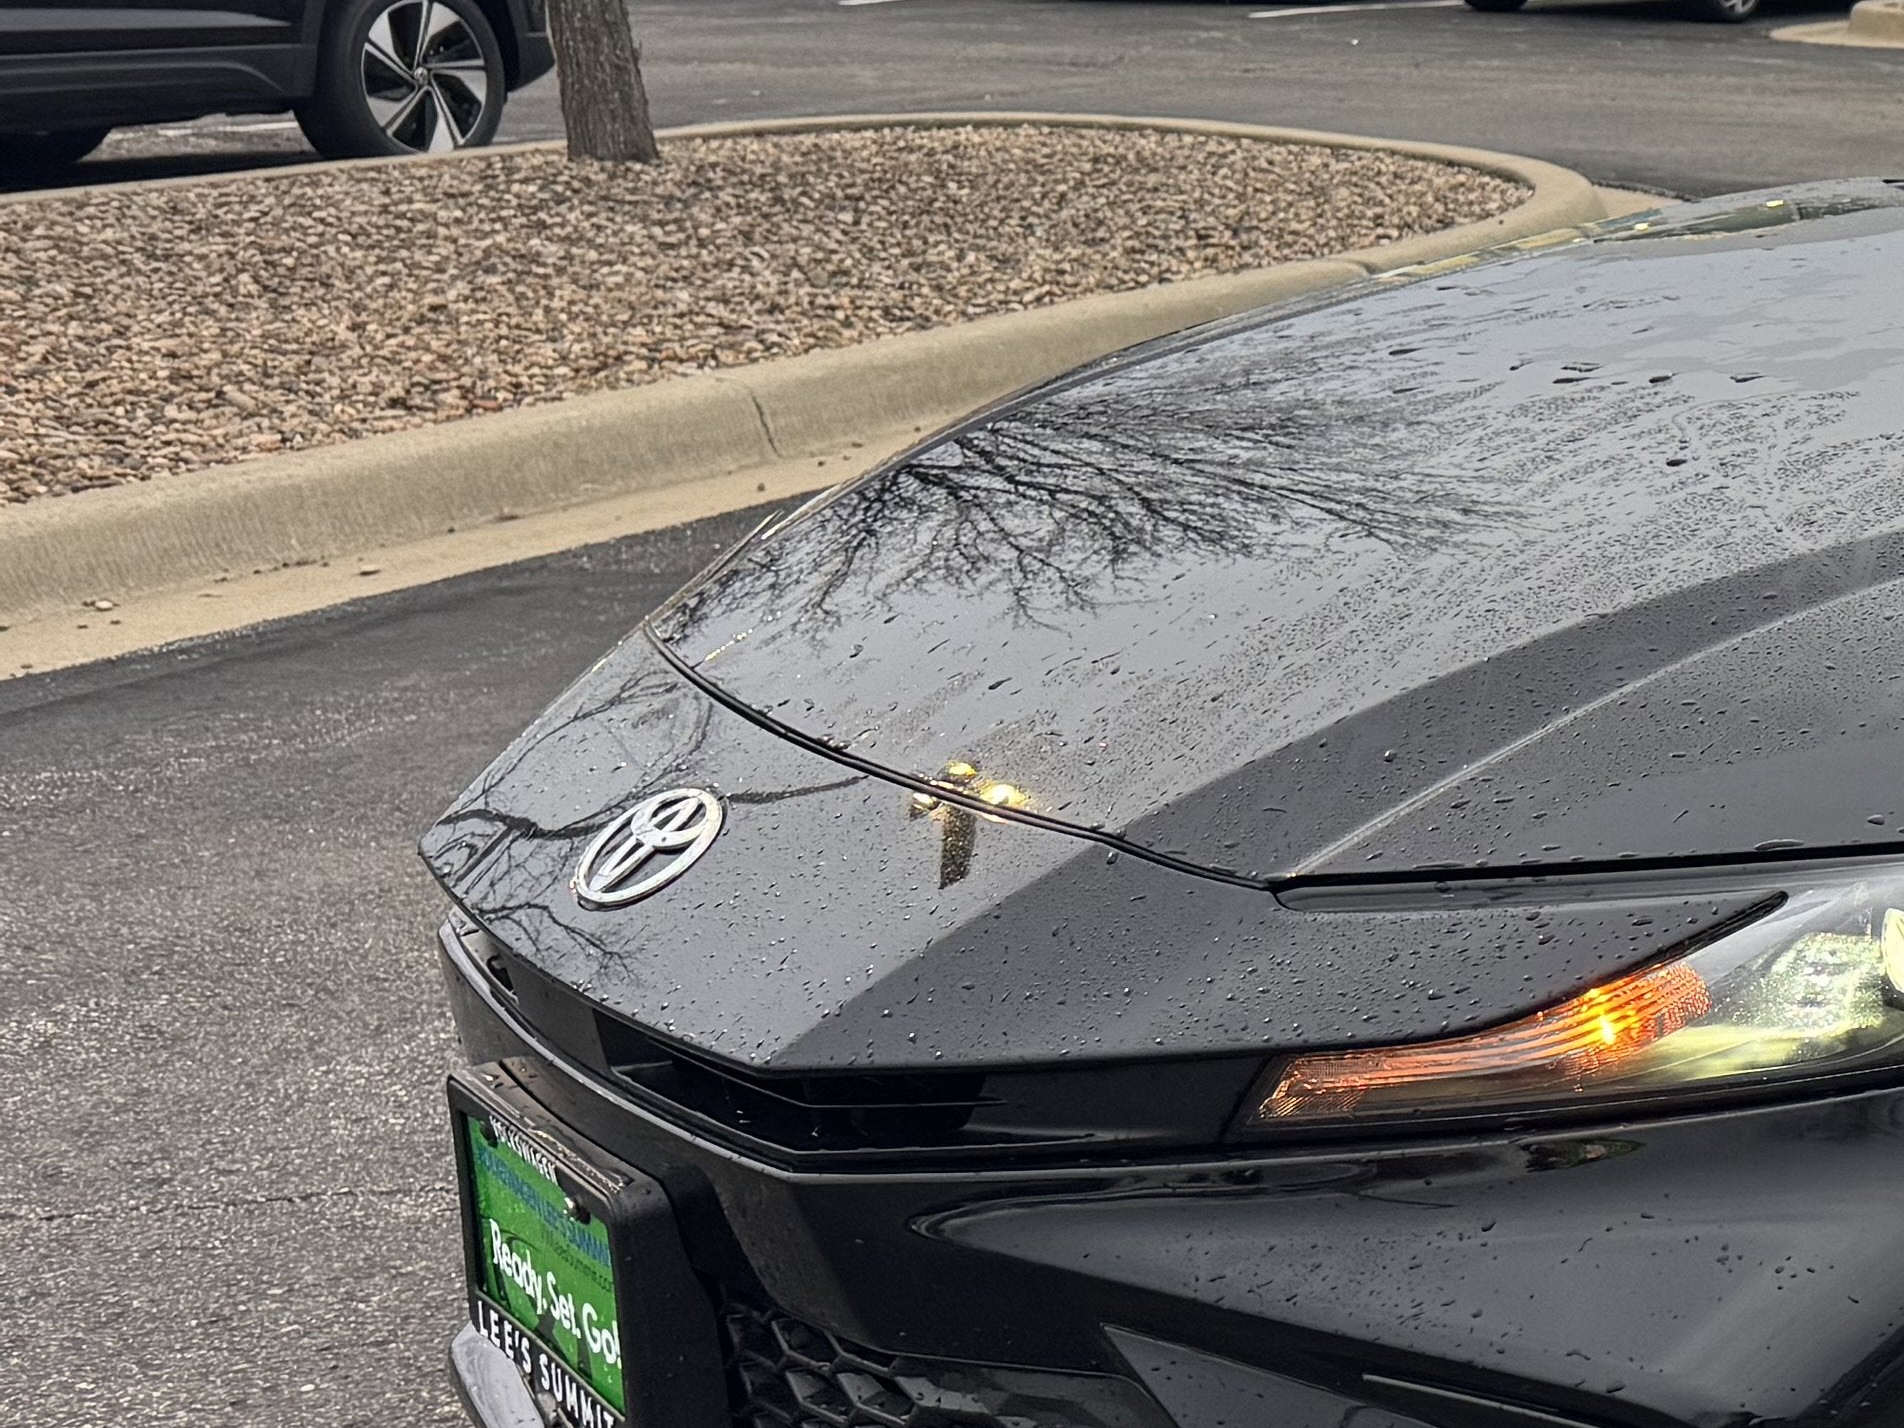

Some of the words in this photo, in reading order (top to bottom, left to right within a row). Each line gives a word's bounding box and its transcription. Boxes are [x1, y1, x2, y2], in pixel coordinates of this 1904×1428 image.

[477, 1300, 532, 1374] LEE'S
[490, 1218, 548, 1315] Ready.
[547, 1271, 581, 1339] Set.
[582, 1302, 622, 1370] Go!
